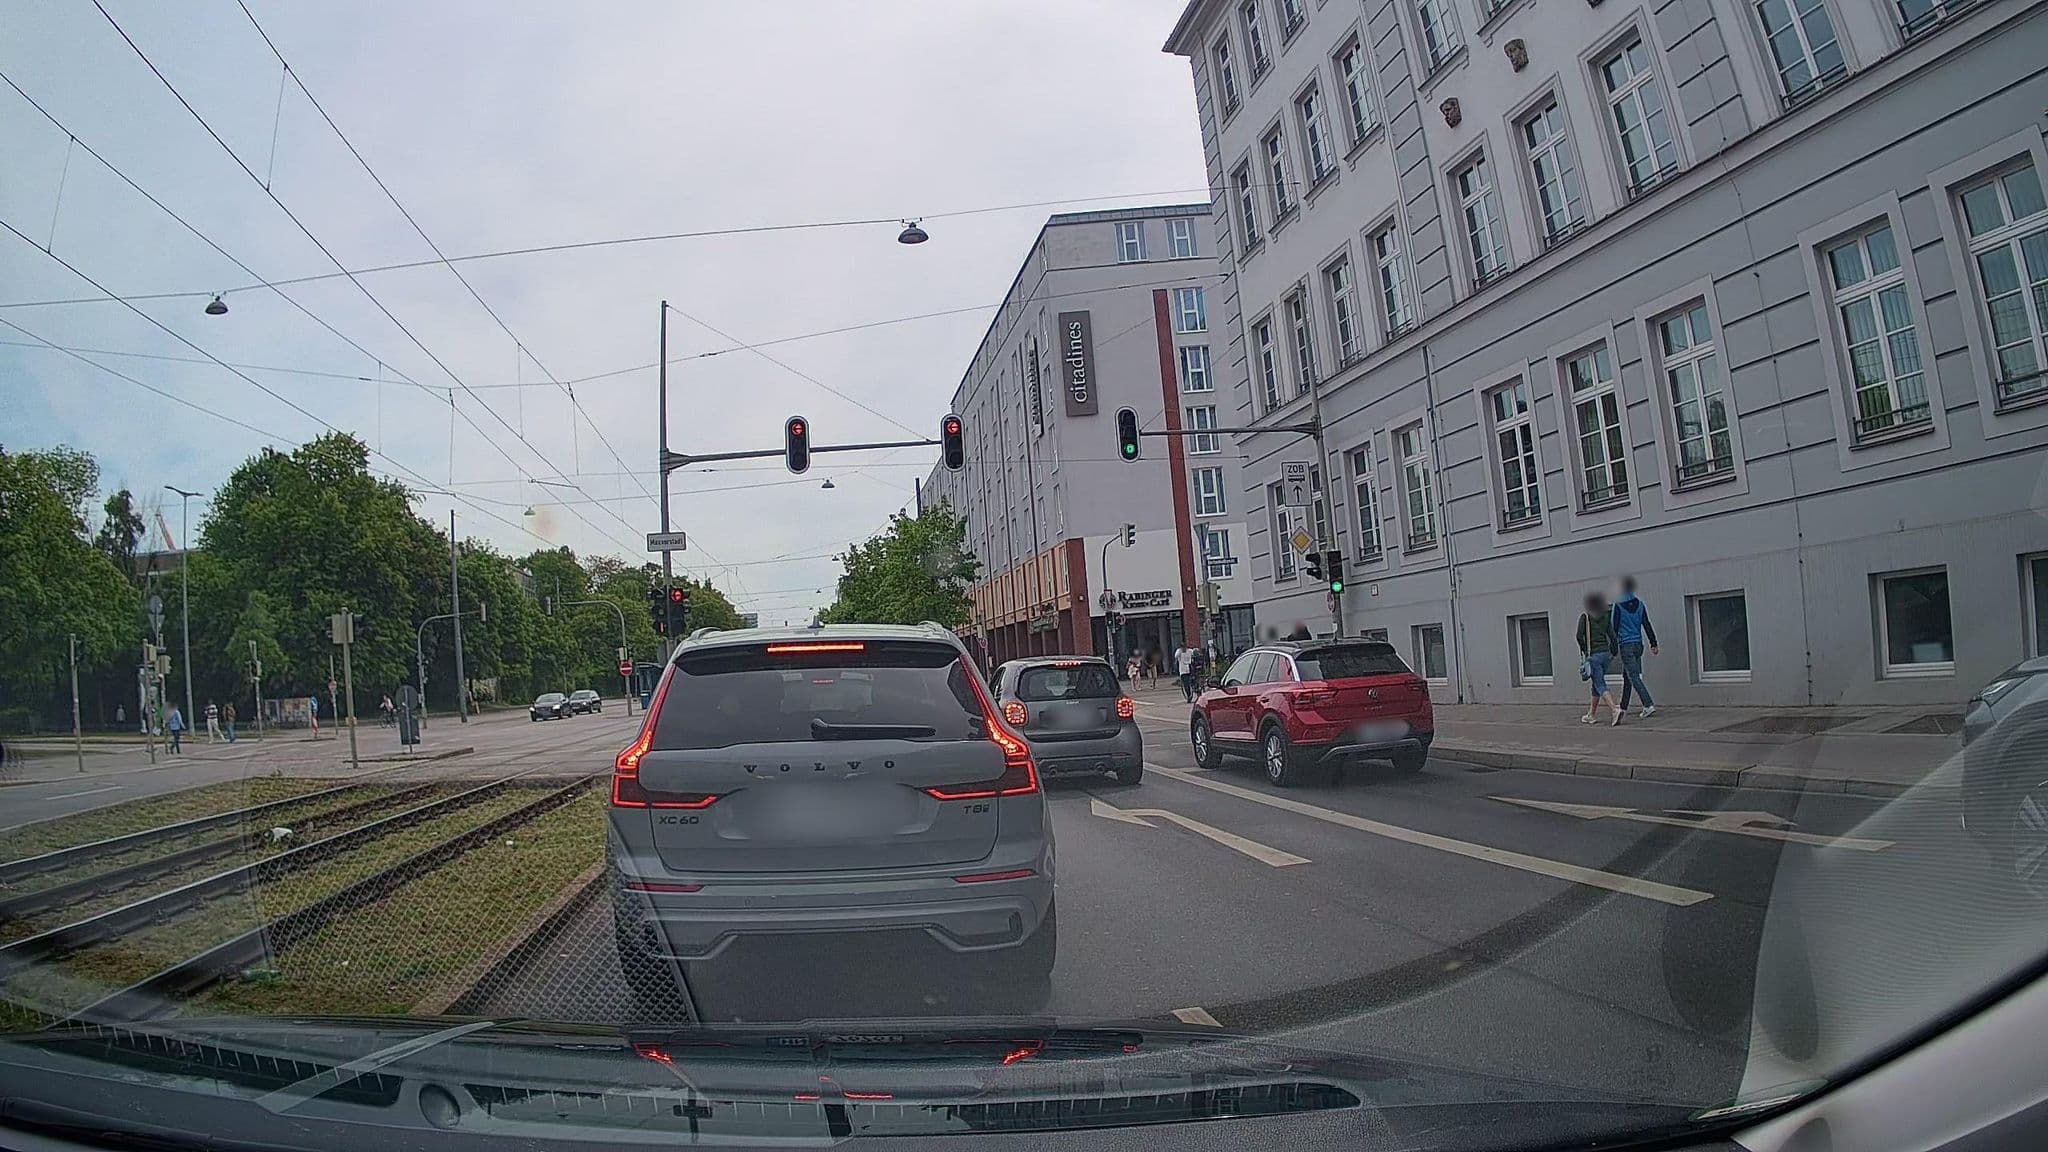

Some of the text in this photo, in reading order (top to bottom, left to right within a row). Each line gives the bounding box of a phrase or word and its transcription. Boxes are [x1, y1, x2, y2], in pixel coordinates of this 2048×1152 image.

[1065, 321, 1088, 403] citadines
[1287, 464, 1305, 473] ZOB
[744, 760, 895, 774] VOLVO
